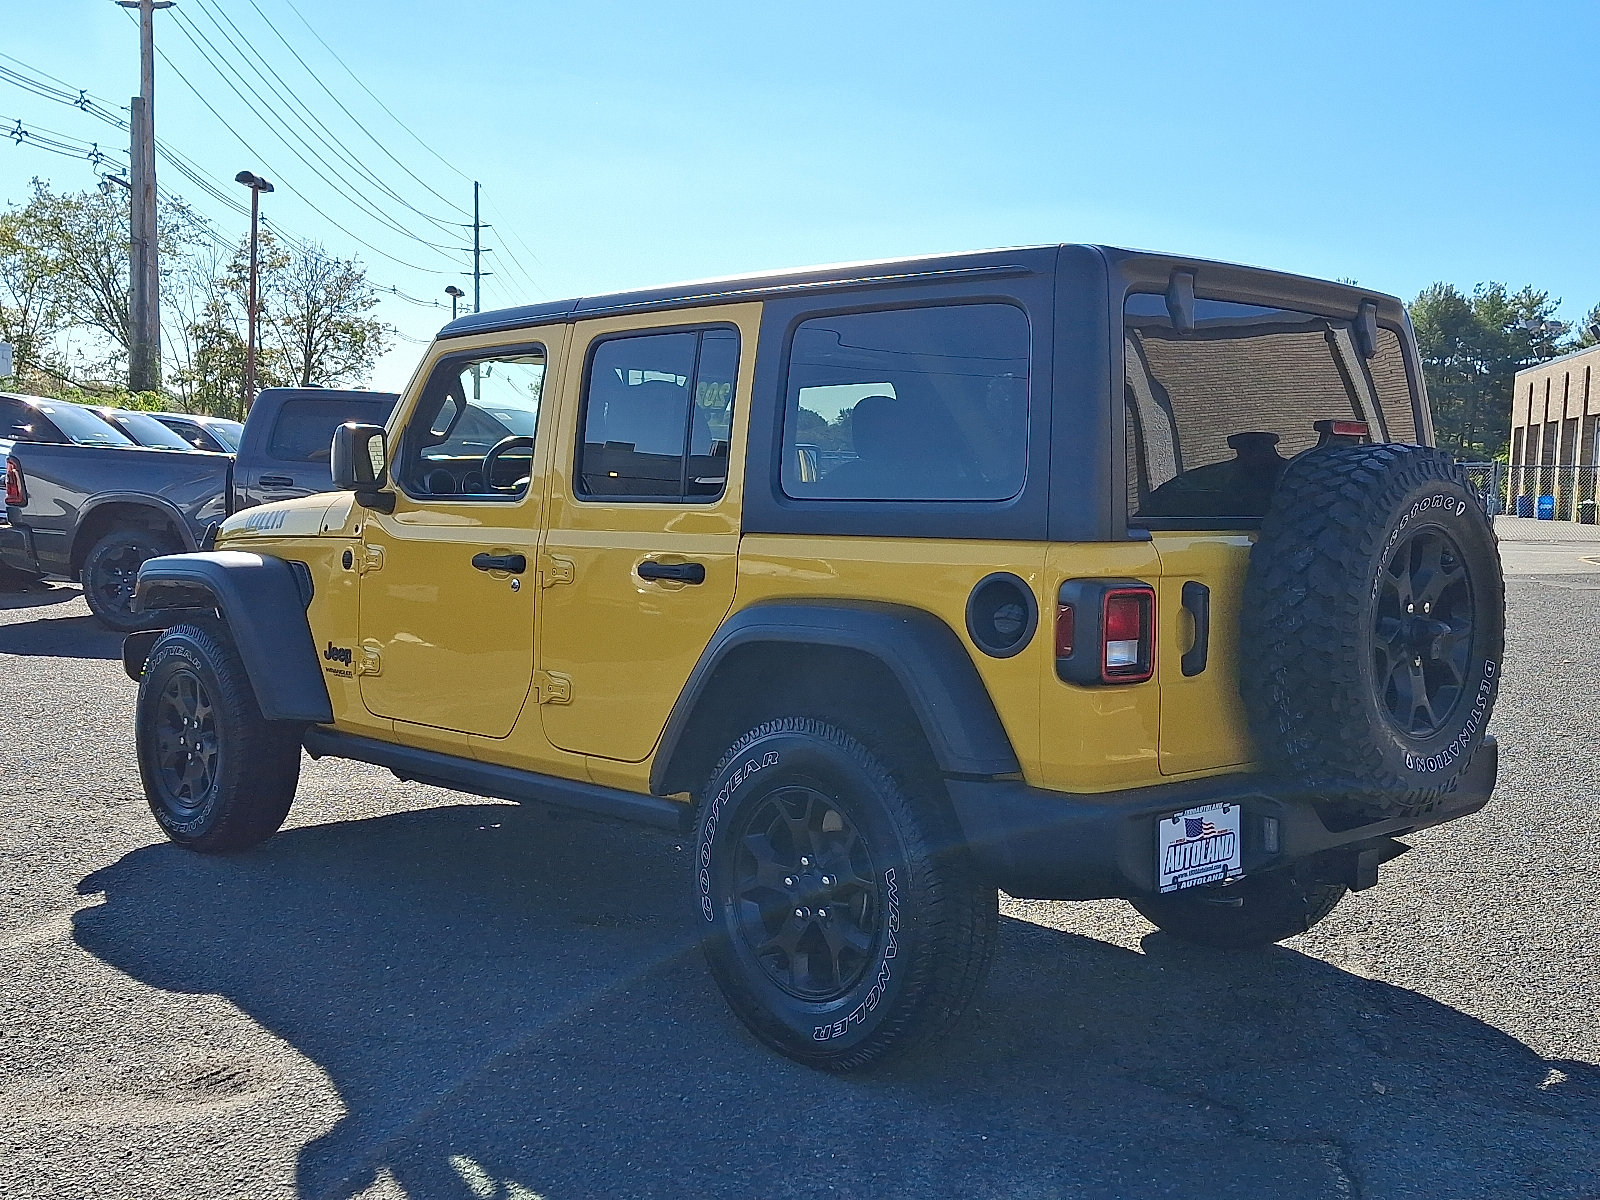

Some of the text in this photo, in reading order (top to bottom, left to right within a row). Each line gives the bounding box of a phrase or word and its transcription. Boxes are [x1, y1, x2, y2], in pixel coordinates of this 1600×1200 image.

[324, 641, 352, 667] Jeep
[1416, 660, 1496, 772] DESTINATION
[700, 751, 779, 922] GOODYEAR
[1164, 834, 1235, 875] AUTOLAND
[1180, 873, 1224, 889] AUTOLAND
[813, 868, 899, 1040] WRANGLER
